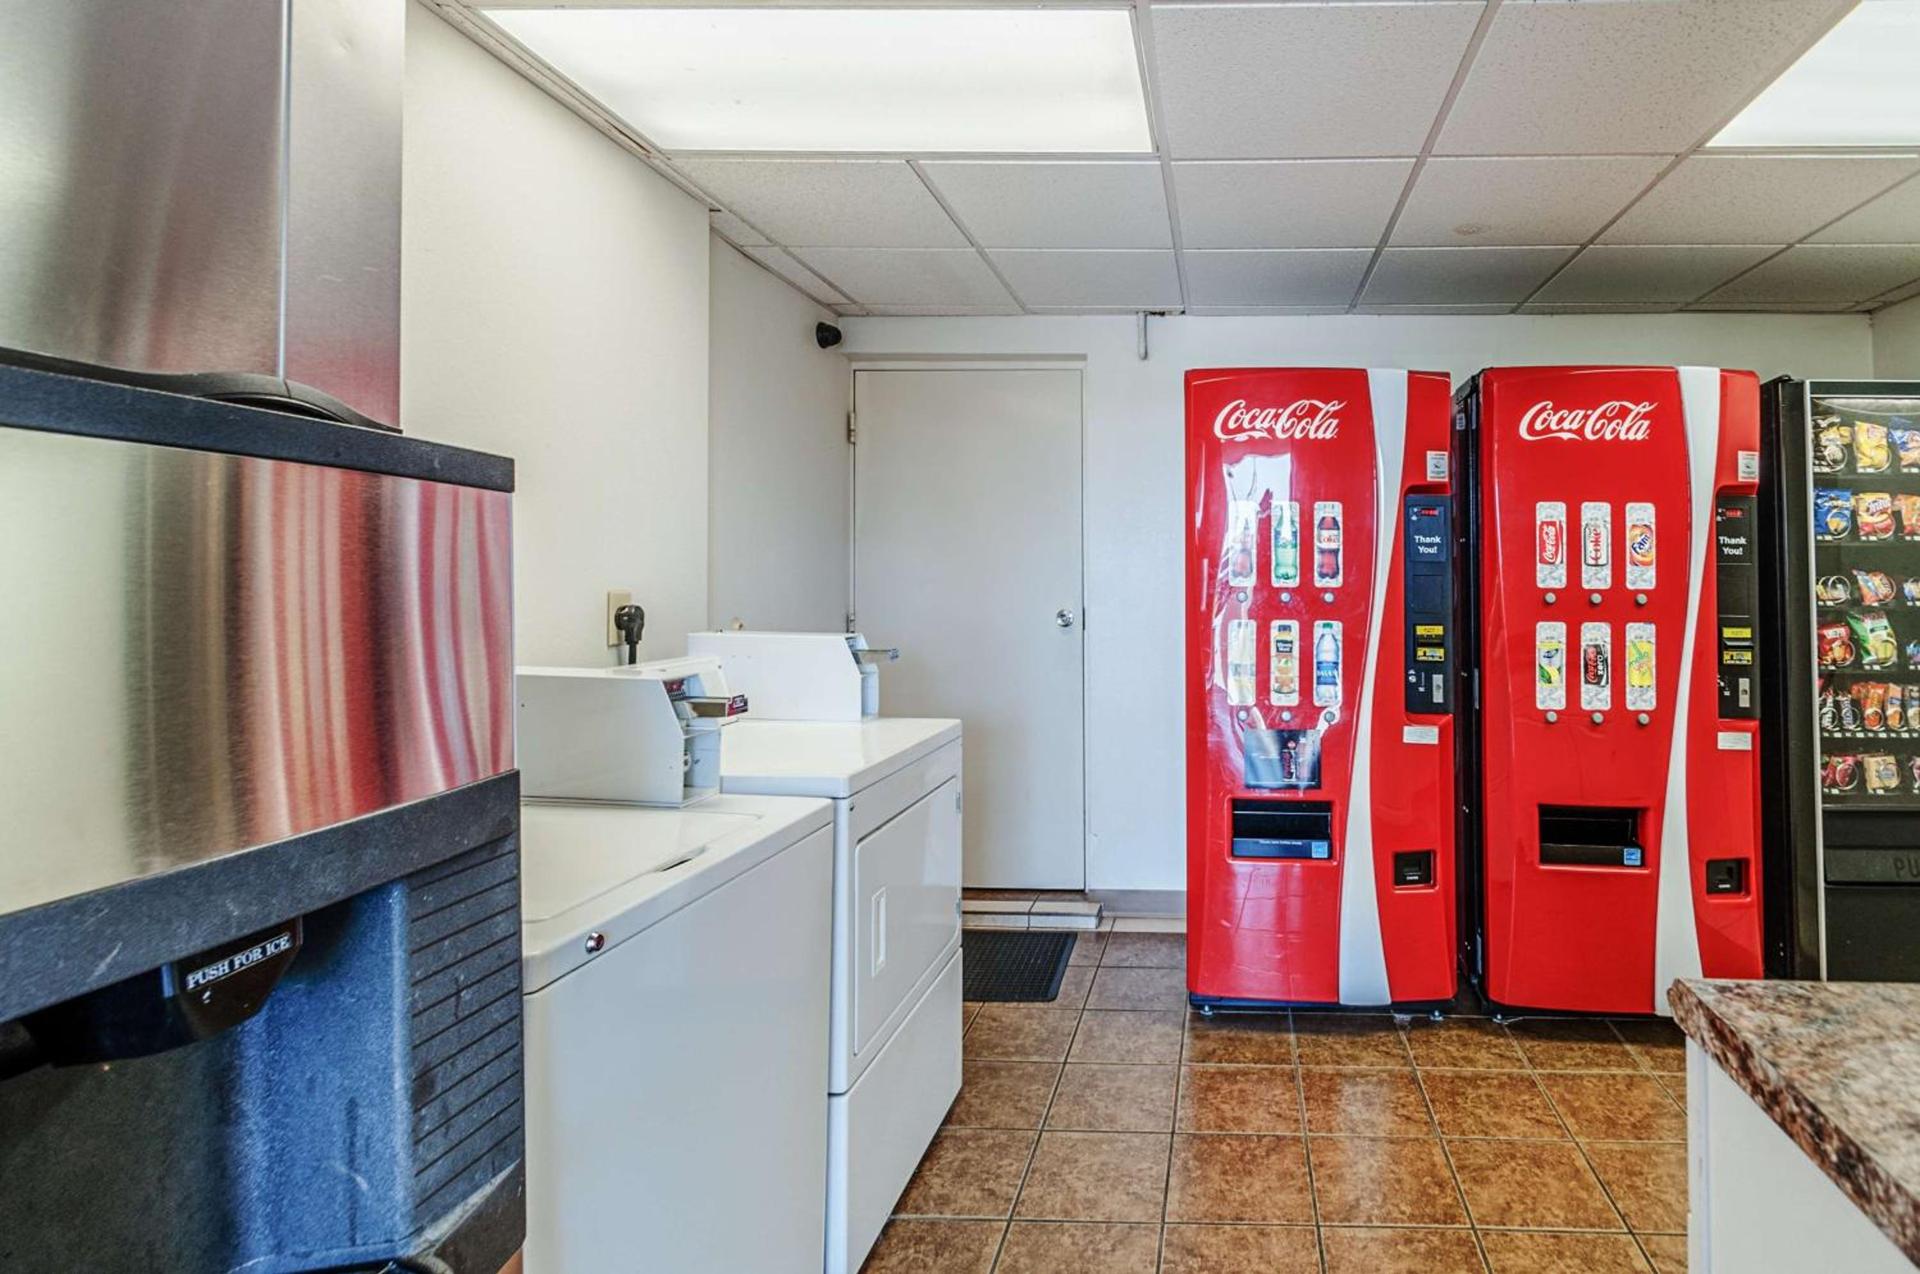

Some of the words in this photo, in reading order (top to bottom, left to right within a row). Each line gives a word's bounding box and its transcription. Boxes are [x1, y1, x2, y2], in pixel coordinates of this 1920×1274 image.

[1213, 399, 1348, 441] Coca-Cola
[1519, 400, 1659, 441] Coca-Cola
[1413, 535, 1442, 544] Thank
[1718, 536, 1747, 545] Thank
[1417, 545, 1438, 554] You!
[1722, 547, 1743, 556] You!
[186, 960, 230, 990] PUSH
[233, 947, 263, 970] FOR
[265, 935, 292, 956] ICE
